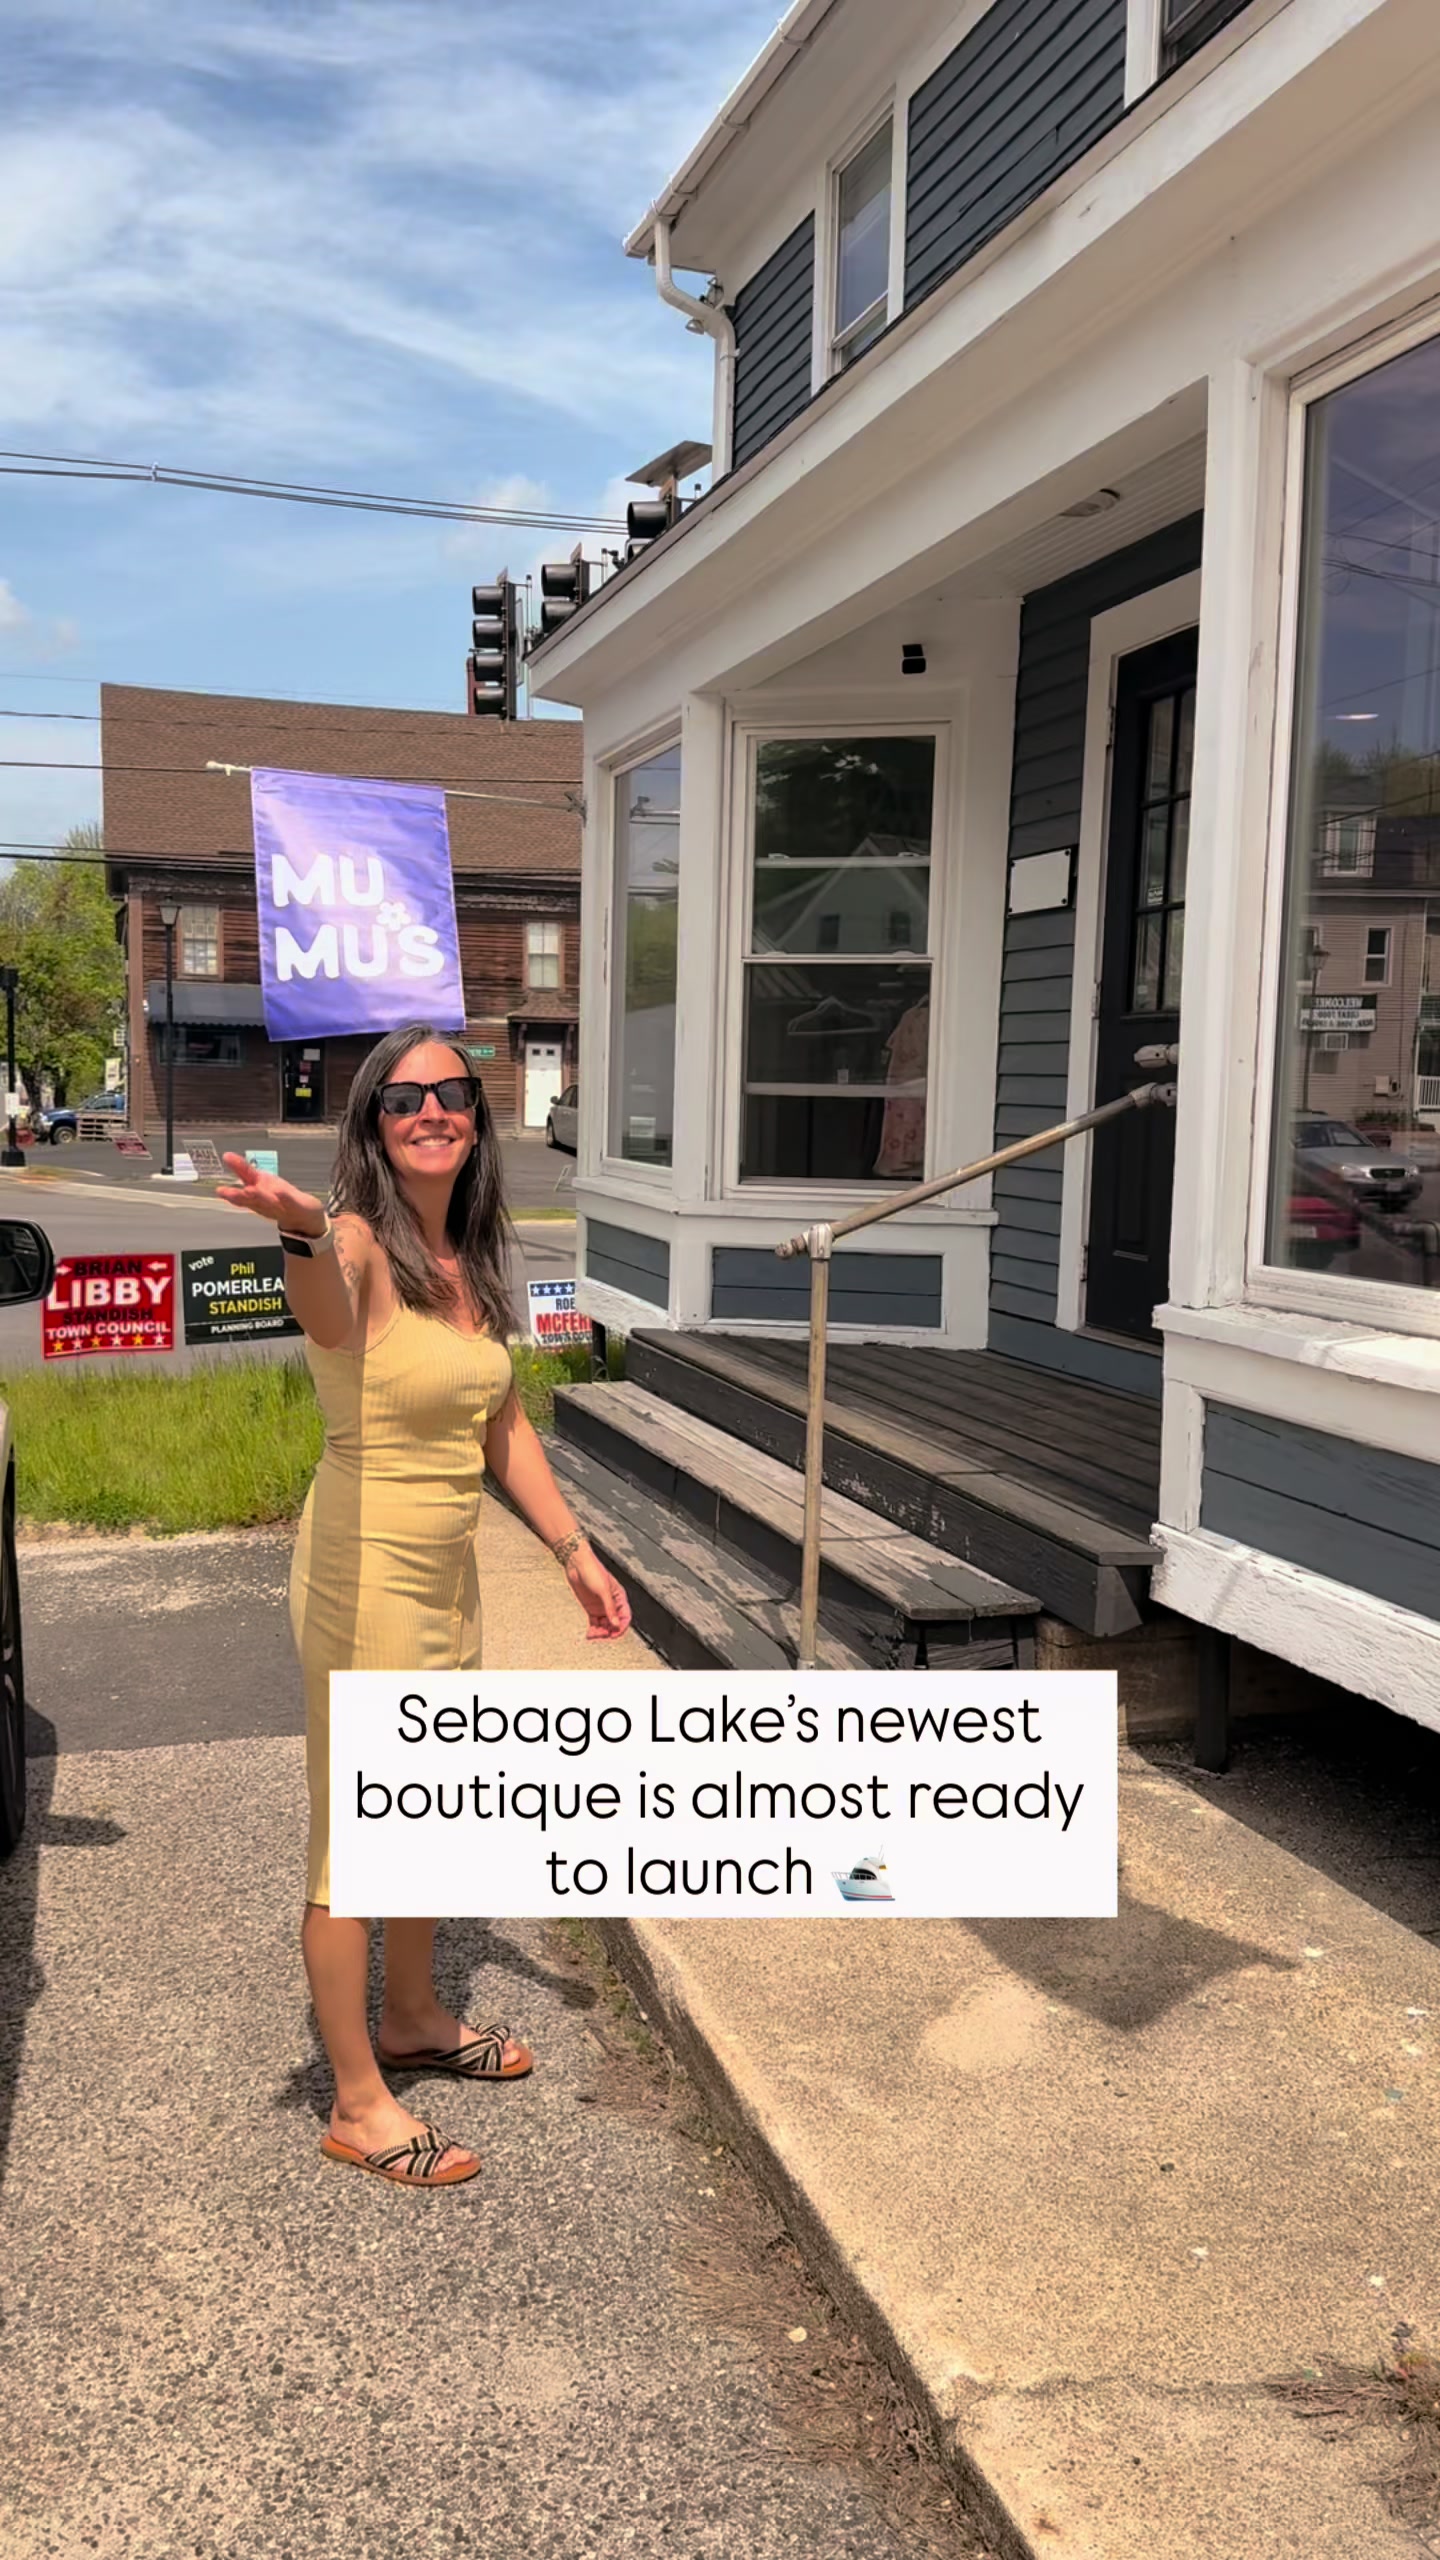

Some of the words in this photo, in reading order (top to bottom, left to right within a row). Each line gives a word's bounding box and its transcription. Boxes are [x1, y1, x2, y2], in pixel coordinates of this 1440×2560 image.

[271, 853, 384, 907] MU
[74, 1260, 142, 1276] BRIAN
[188, 1255, 215, 1271] vote
[230, 1261, 255, 1275] Phil
[47, 1276, 172, 1311] LIBBY
[192, 1277, 285, 1297] POMERLEA
[209, 1297, 282, 1315] STANDISH
[63, 1308, 153, 1325] STANDISH
[45, 1323, 92, 1340] TOWN
[95, 1321, 171, 1335] COUNCIL
[210, 1321, 254, 1334] PLANNING
[255, 1319, 284, 1329] BOARD
